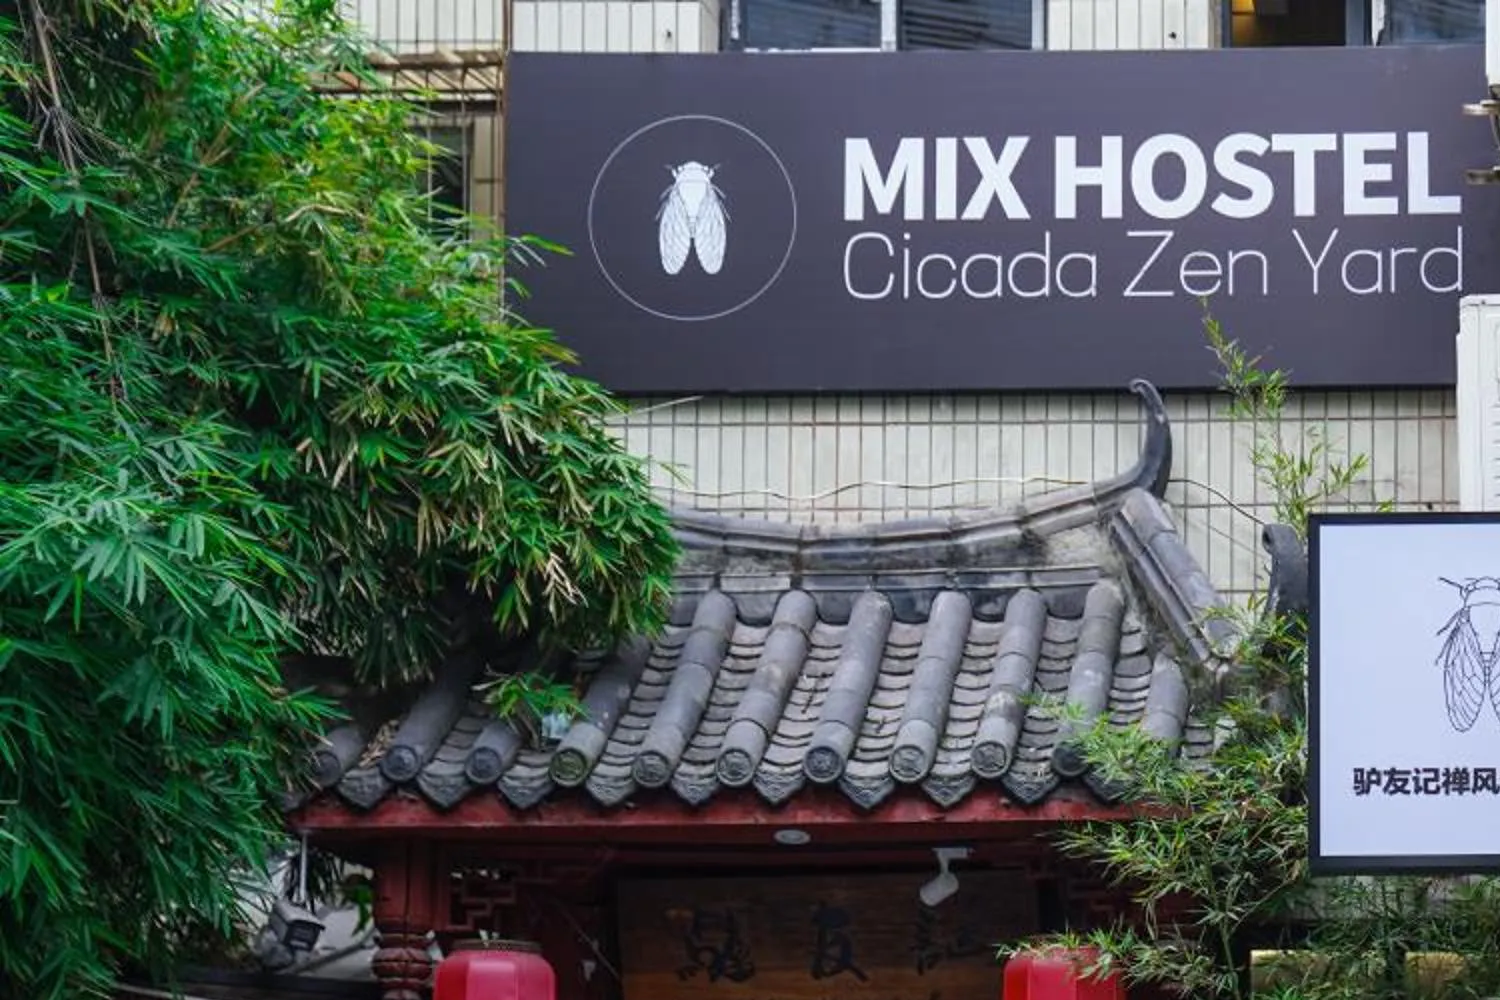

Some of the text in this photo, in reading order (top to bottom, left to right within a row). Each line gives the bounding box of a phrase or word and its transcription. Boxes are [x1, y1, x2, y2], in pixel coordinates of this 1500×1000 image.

[843, 131, 1463, 221] MIX HOSTEL
[843, 226, 1464, 300] Cicada Zen Yard
